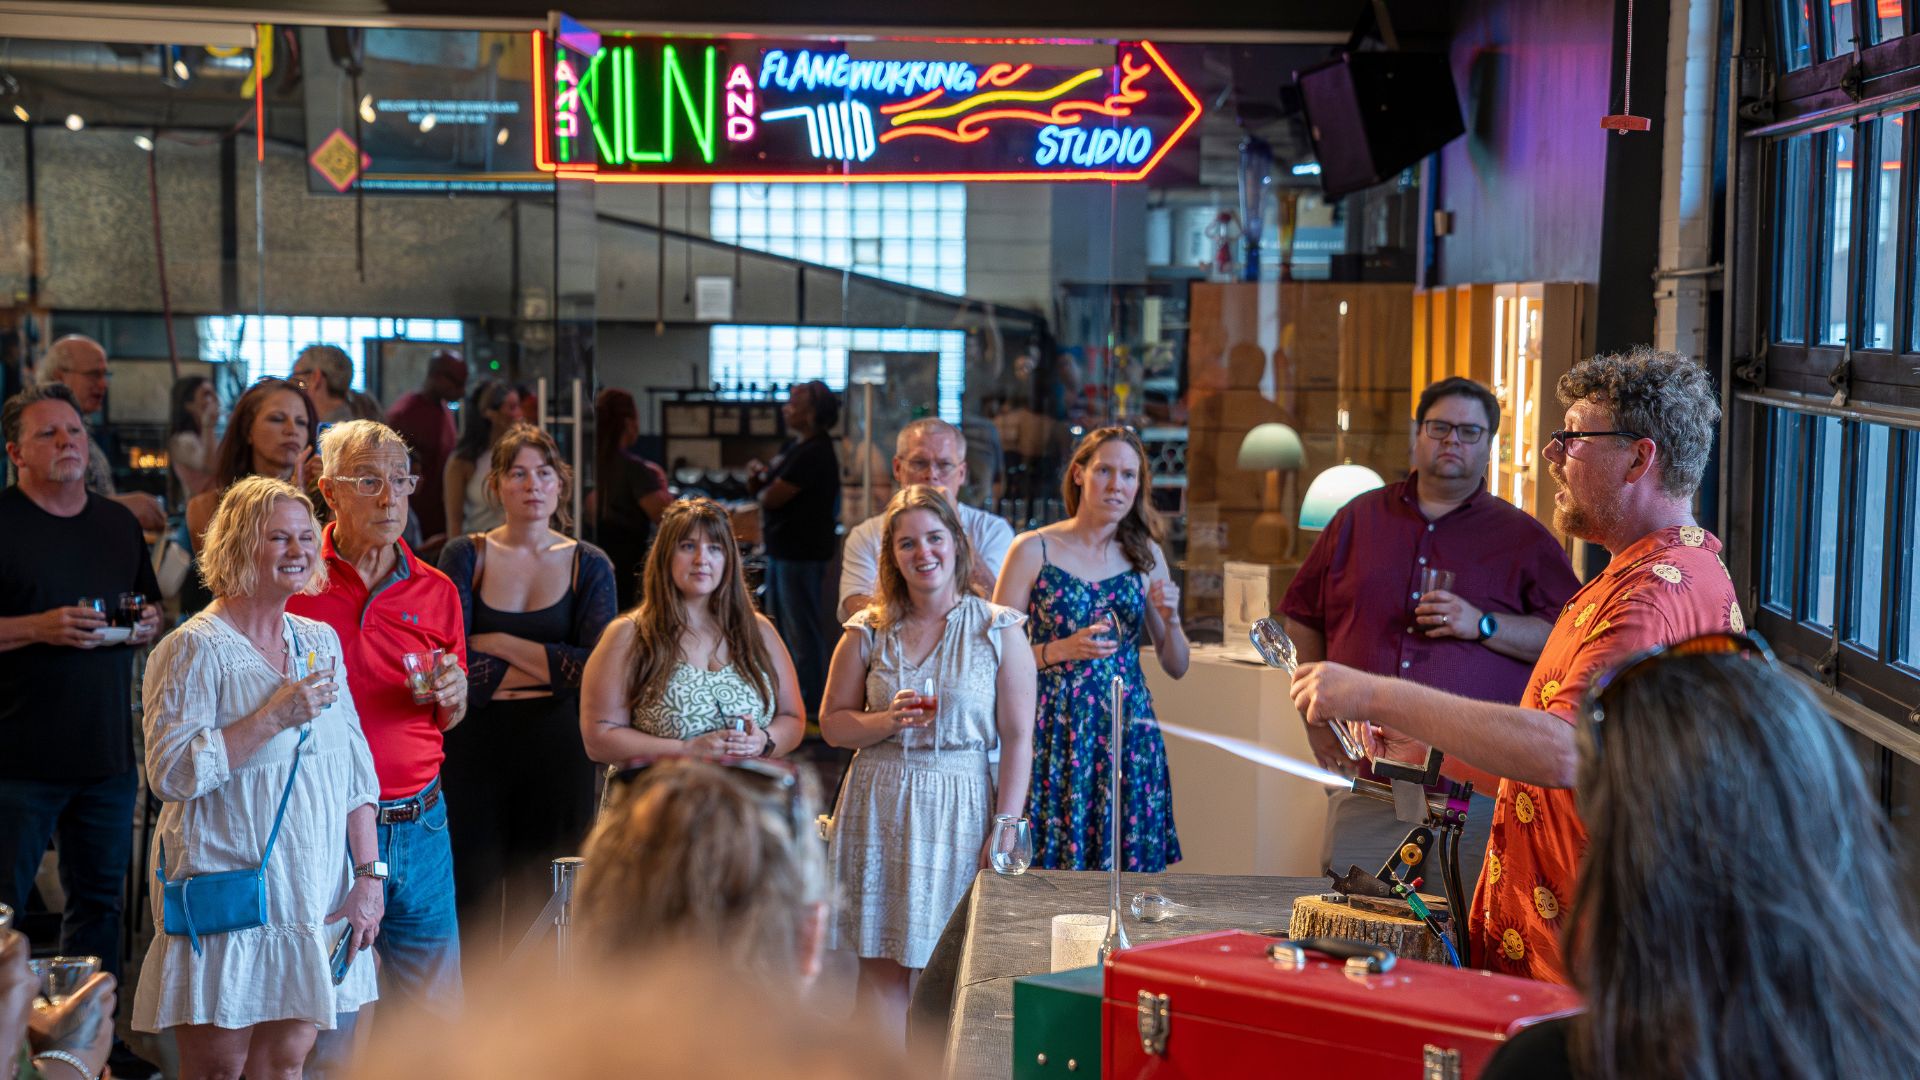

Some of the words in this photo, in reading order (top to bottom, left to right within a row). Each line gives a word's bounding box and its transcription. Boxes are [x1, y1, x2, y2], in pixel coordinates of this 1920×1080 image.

[558, 47, 716, 163] KILN
[726, 65, 754, 141] AND
[1035, 125, 1152, 167] STUDIO
